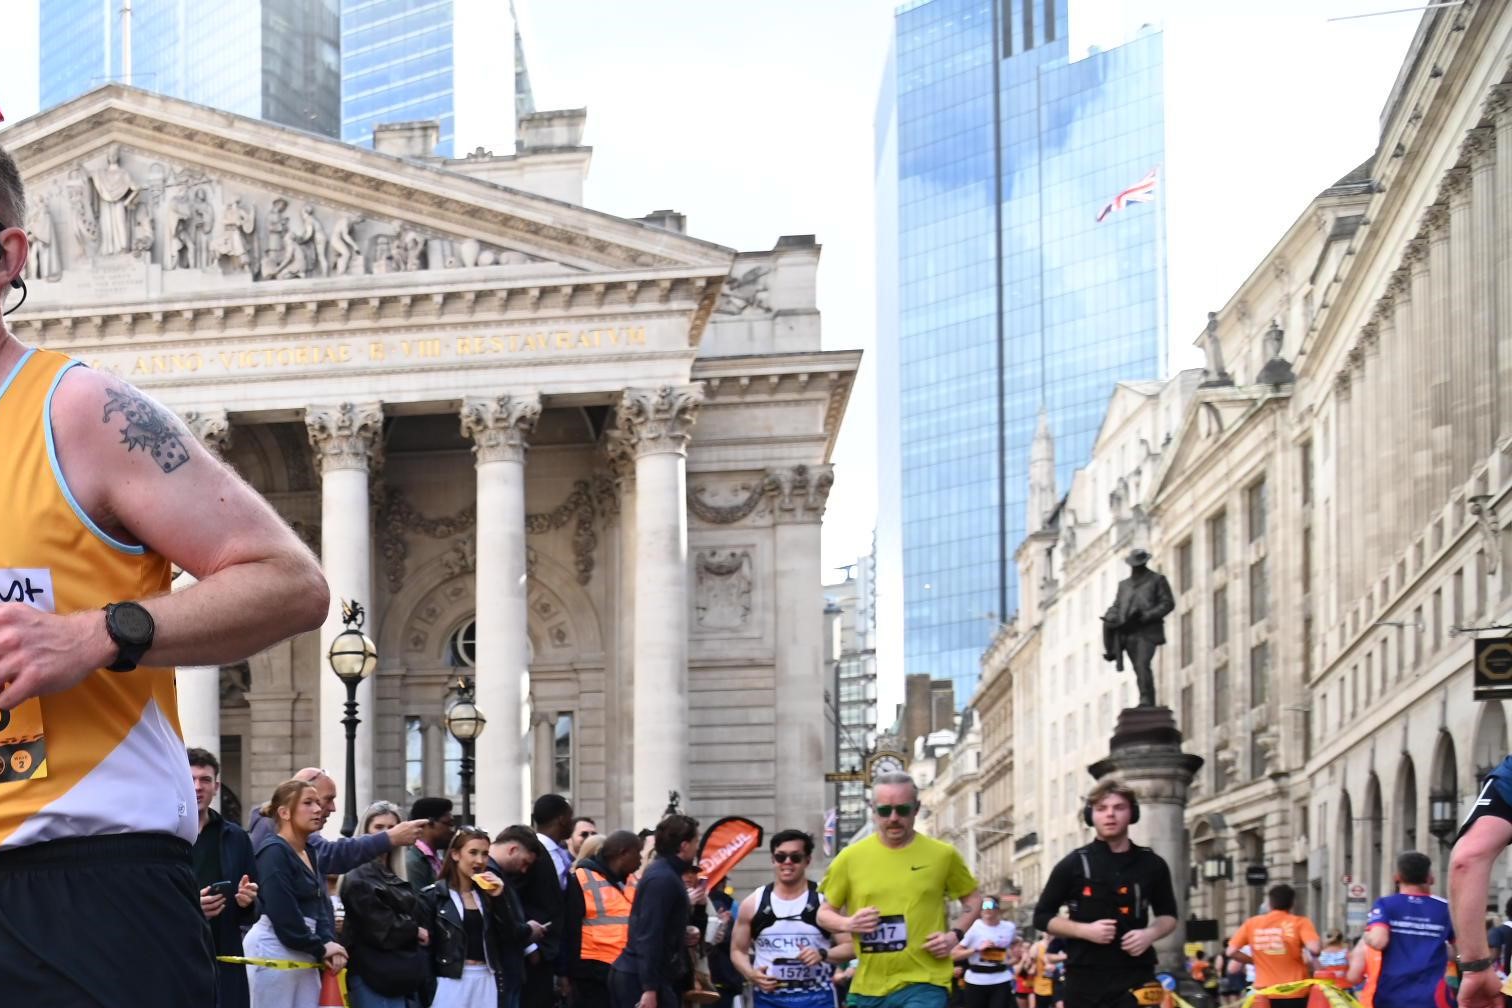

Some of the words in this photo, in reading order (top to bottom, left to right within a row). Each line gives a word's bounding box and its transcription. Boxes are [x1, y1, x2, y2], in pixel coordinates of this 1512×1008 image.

[131, 351, 205, 376] ANNO
[219, 343, 353, 370] VICTORIAE
[400, 338, 441, 359] VIII
[456, 326, 647, 356] RESTAVRATVM
[18, 760, 25, 769] 2
[779, 967, 810, 978] 1572
